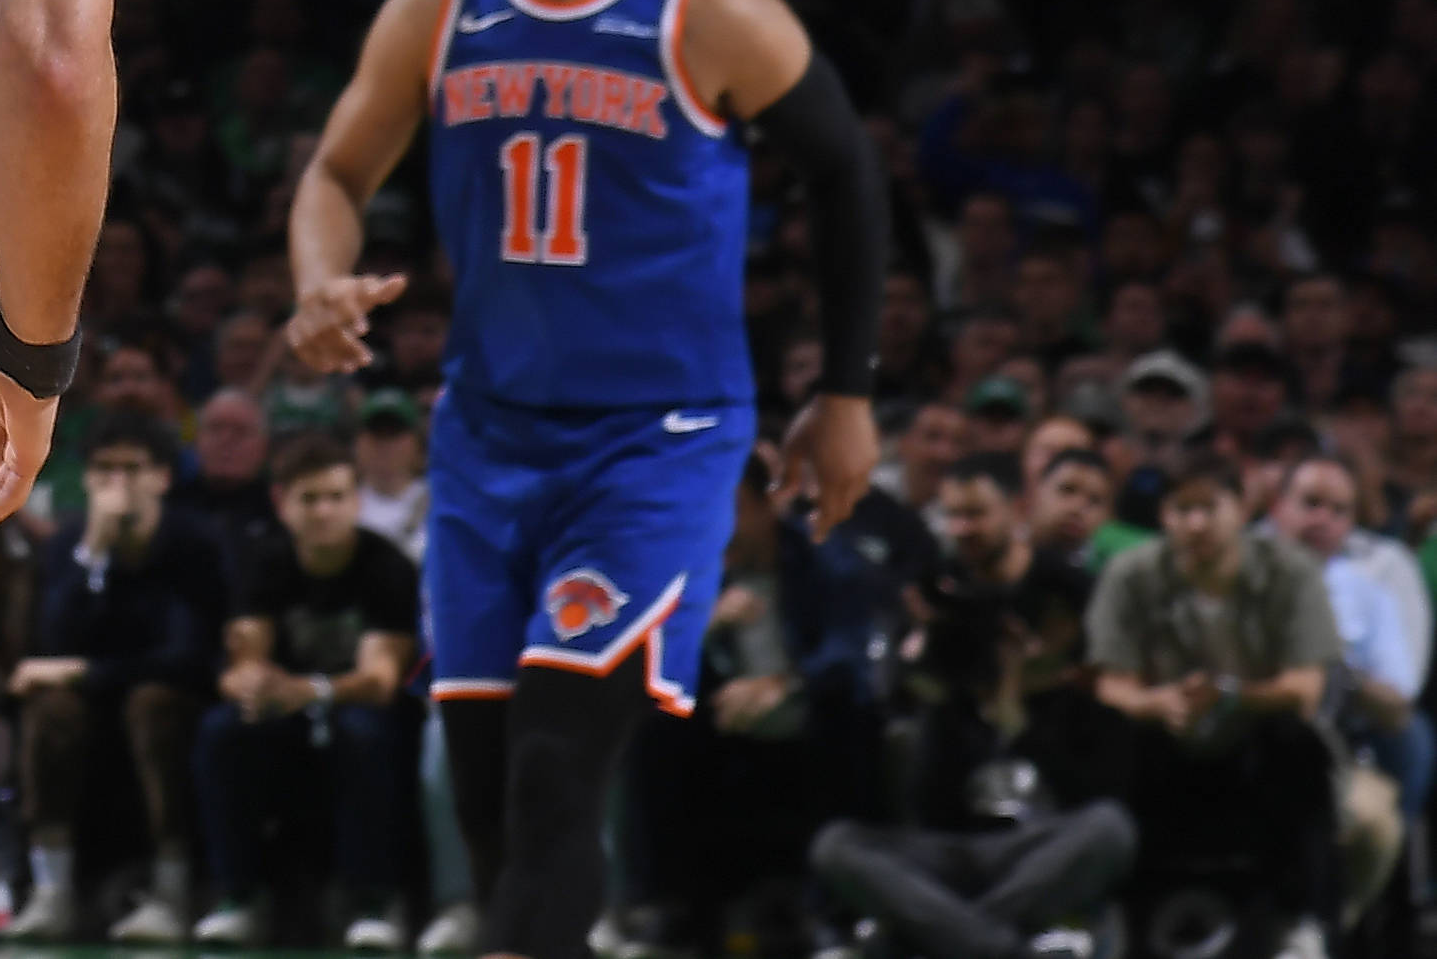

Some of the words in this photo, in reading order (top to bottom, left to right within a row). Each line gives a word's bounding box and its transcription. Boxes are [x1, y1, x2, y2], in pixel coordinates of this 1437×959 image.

[443, 62, 538, 127] NEW
[541, 60, 669, 139] YORK
[500, 132, 589, 266] 11
